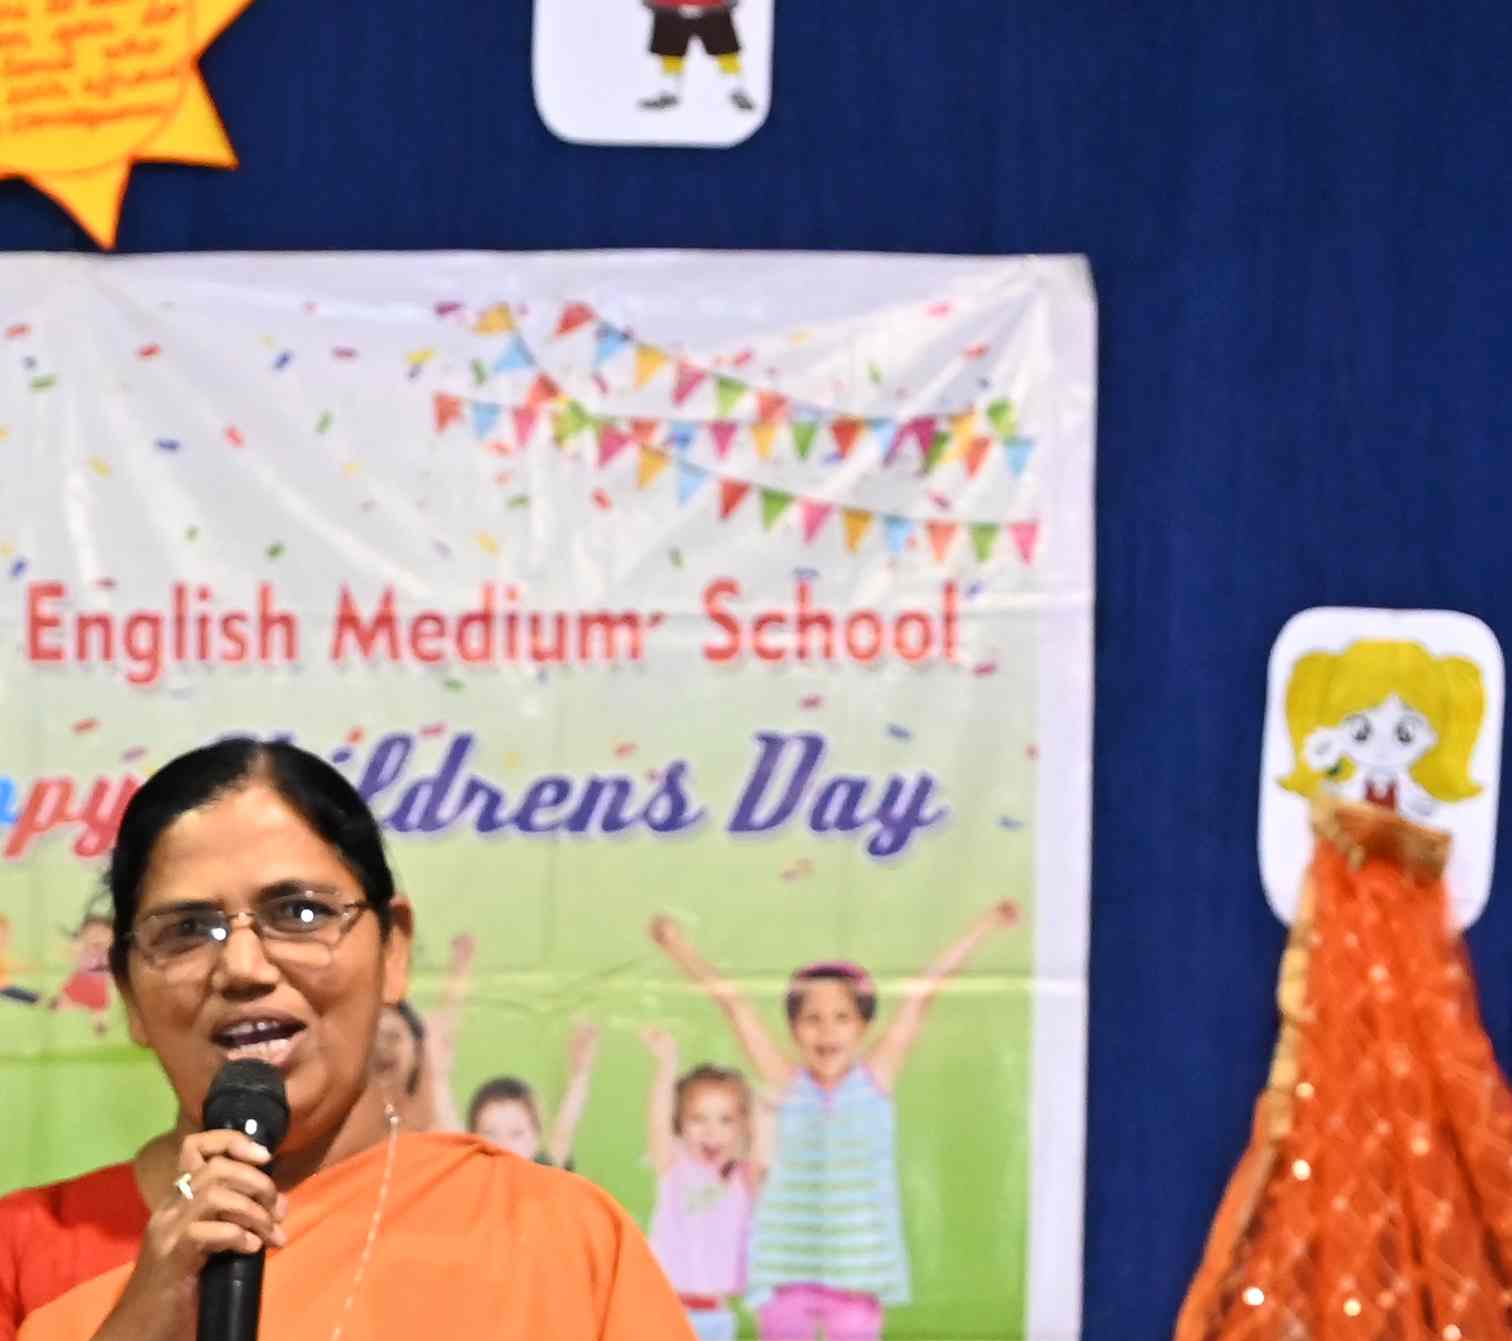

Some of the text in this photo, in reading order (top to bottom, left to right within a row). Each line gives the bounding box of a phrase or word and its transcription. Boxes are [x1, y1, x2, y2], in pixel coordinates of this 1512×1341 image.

[25, 582, 298, 685] English
[329, 582, 647, 662] Medium
[701, 577, 959, 663] School
[216, 730, 704, 836] ldrens
[727, 730, 948, 857] Day
